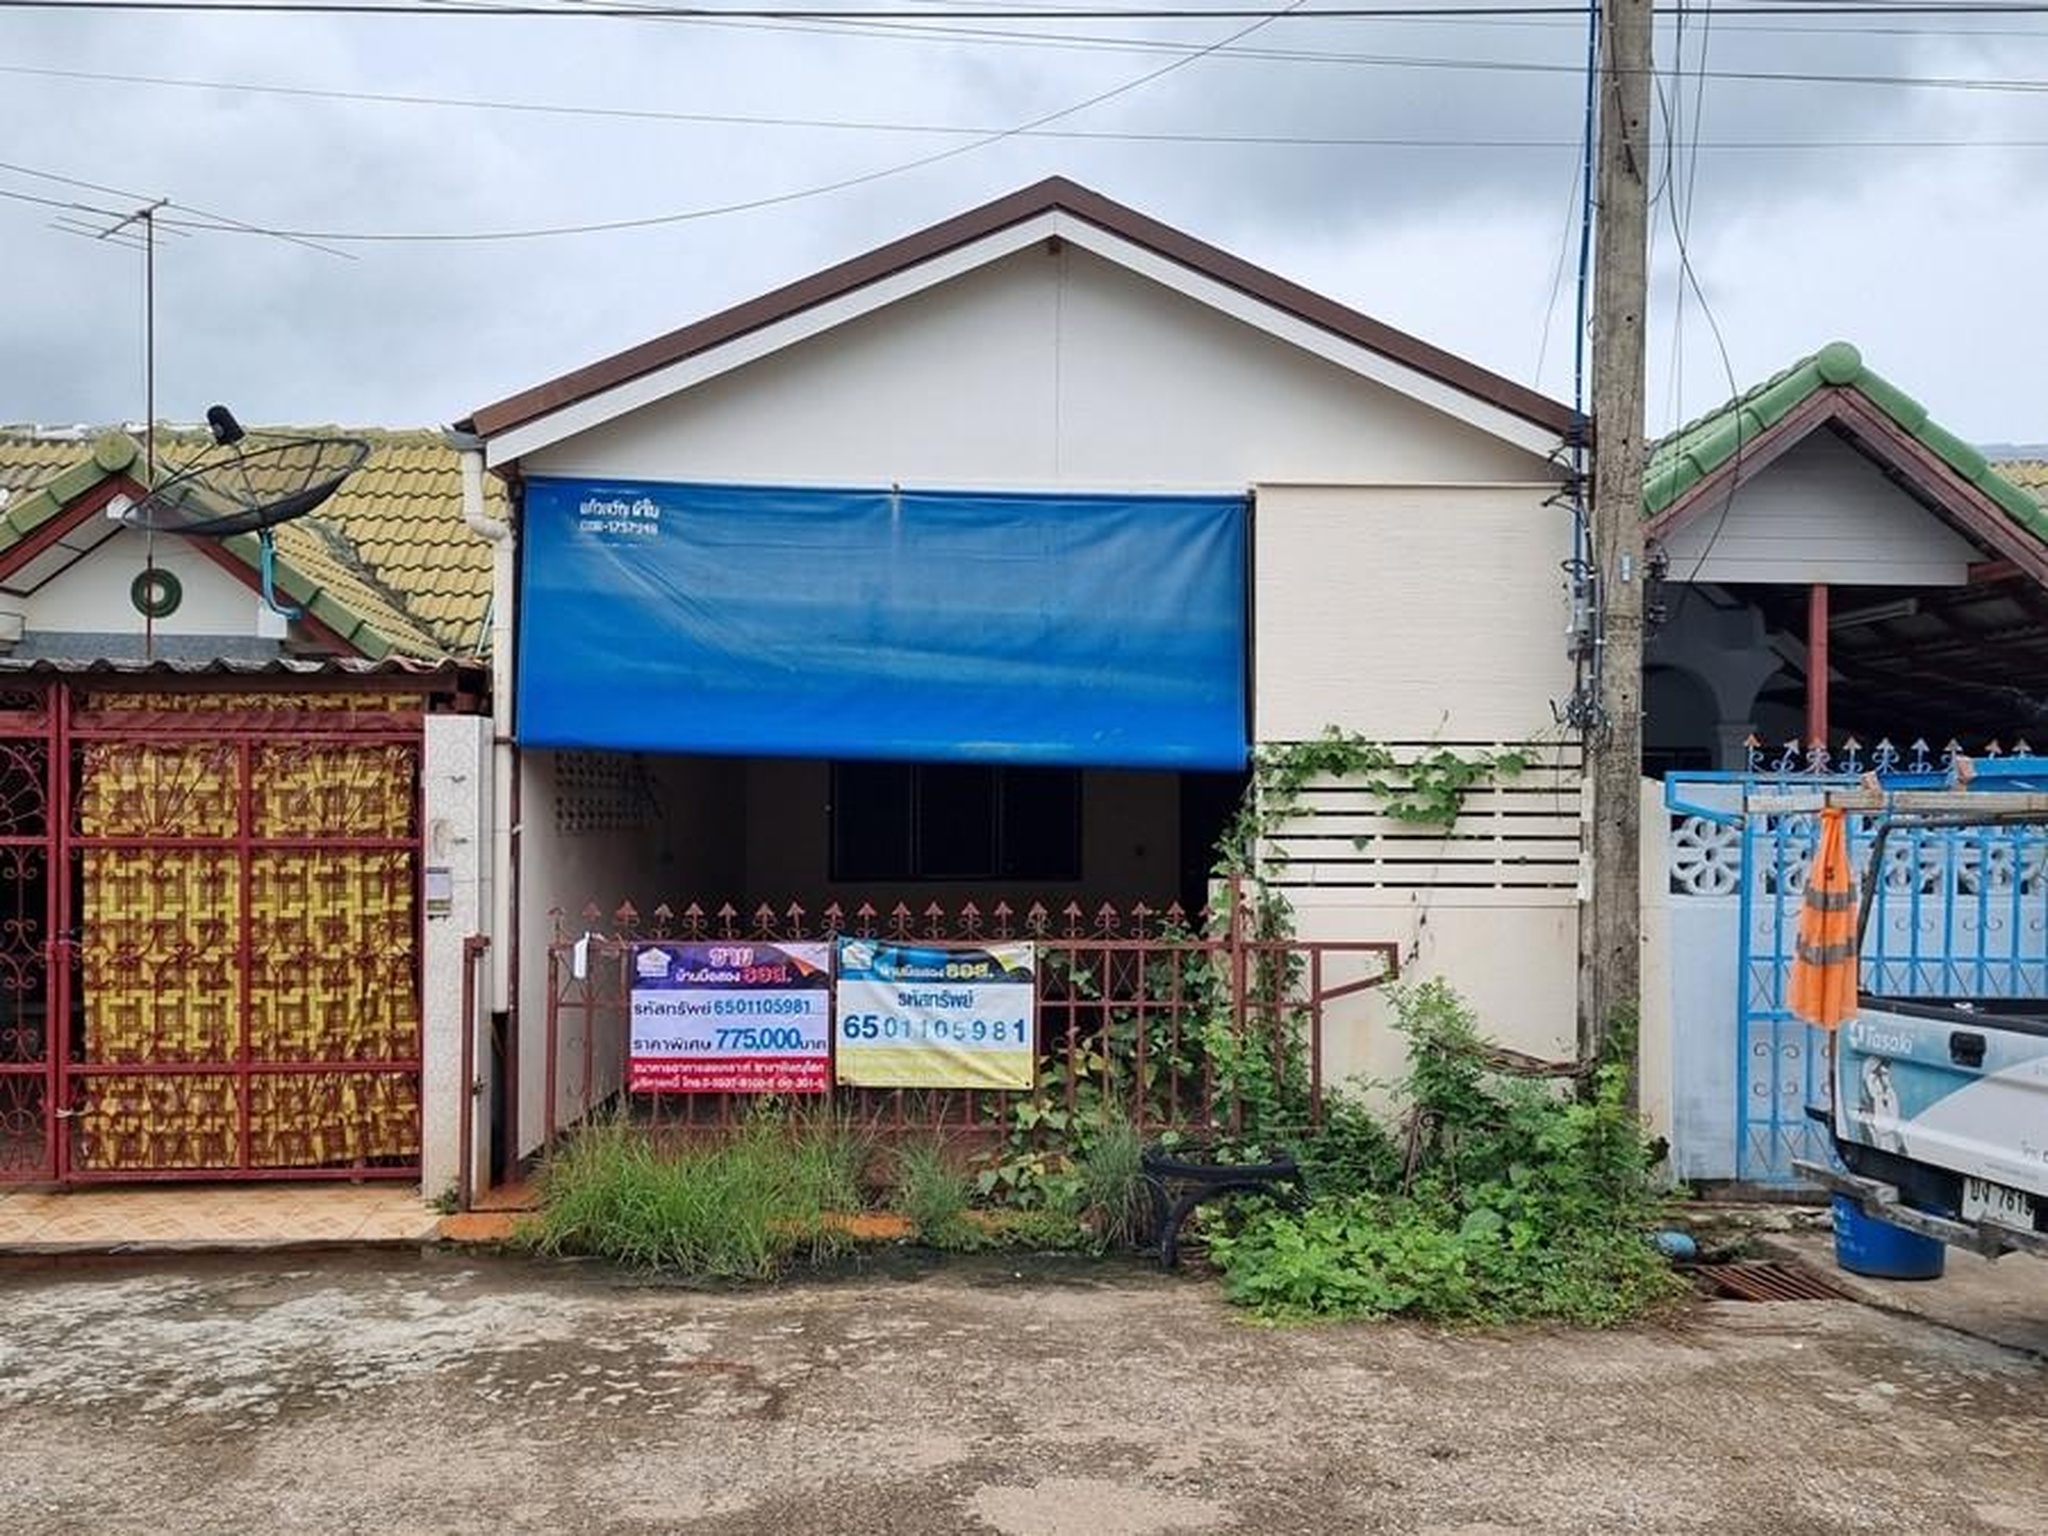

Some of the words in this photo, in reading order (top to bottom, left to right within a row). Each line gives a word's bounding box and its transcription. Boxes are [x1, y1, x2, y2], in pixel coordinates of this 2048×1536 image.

[708, 947, 755, 968] ขาย
[675, 967, 741, 983] บ้านมือสอง
[898, 988, 974, 1009] รหัสทรัพย์
[633, 999, 713, 1016] รหัสทรัพย์
[713, 999, 812, 1015] 6501105981
[633, 1036, 712, 1051] ราคาพิเศษ
